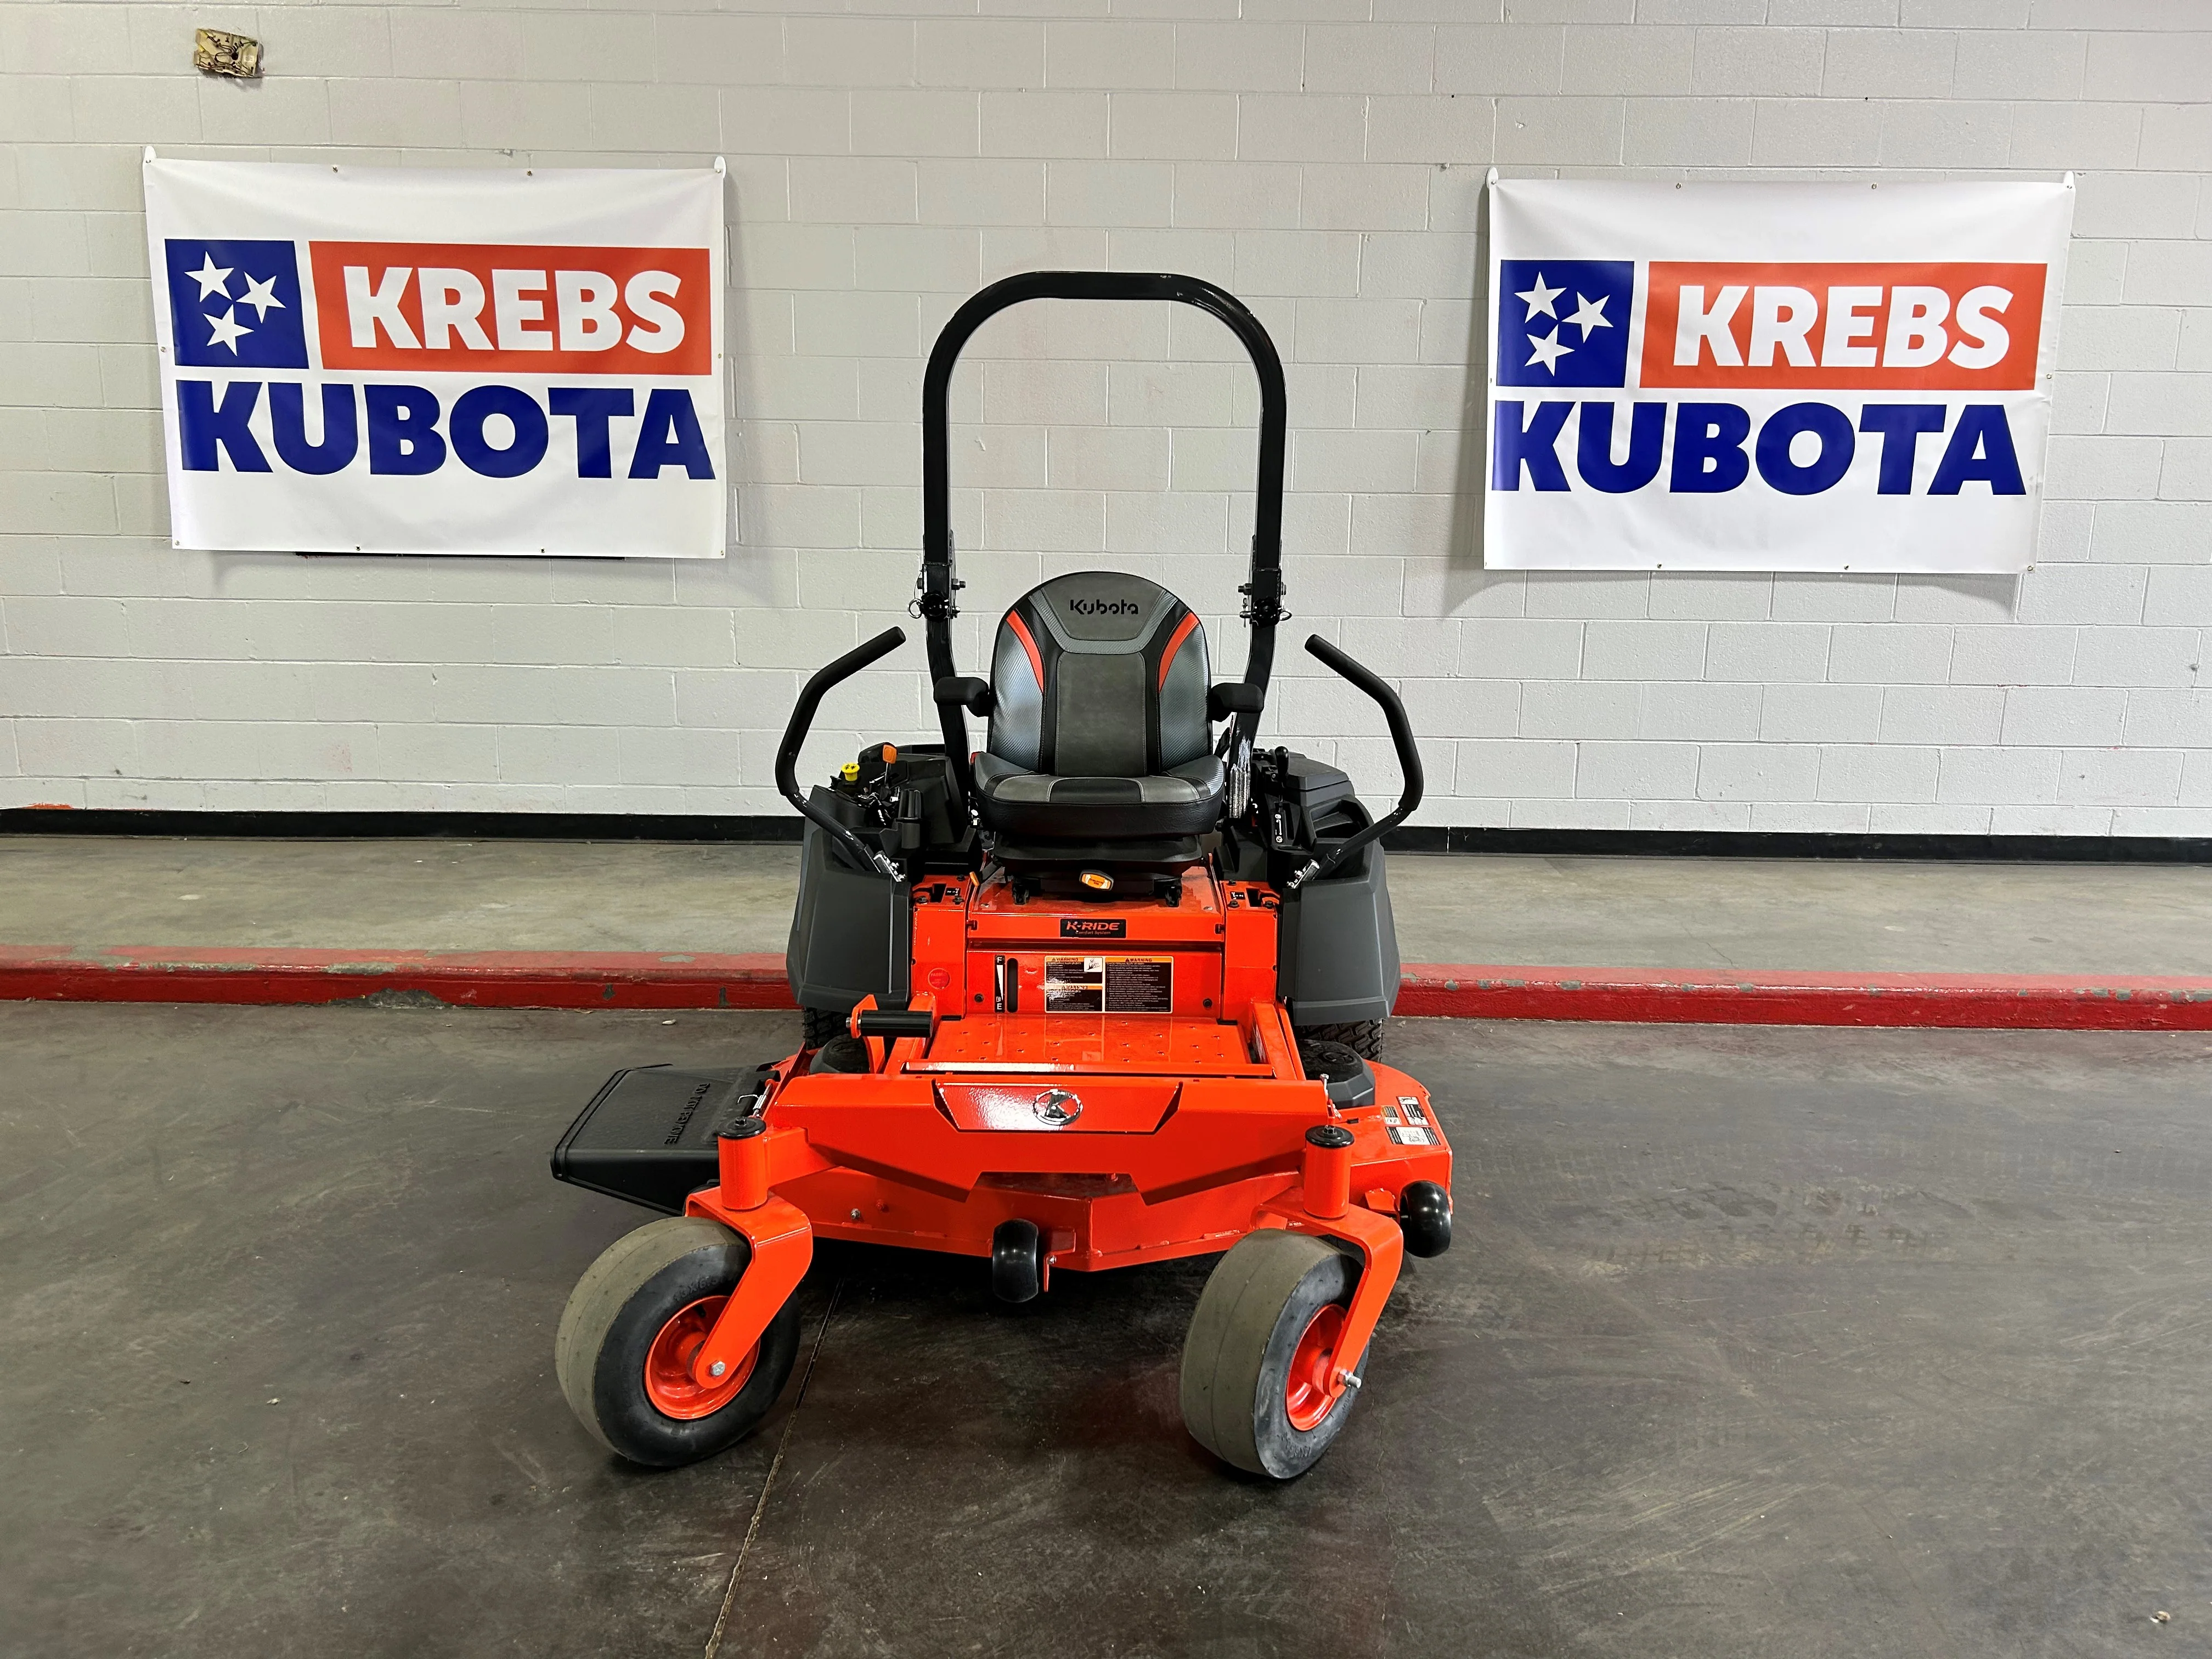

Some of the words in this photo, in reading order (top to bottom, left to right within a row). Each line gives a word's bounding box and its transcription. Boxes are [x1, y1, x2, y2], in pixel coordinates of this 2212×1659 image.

[343, 266, 686, 354] KREBS
[1673, 285, 2013, 369] KREBS
[176, 380, 716, 480] KUBOTA
[1492, 400, 2027, 496] KUBOTA
[1070, 599, 1138, 614] Kubota
[1066, 922, 1120, 930] K-RIDE
